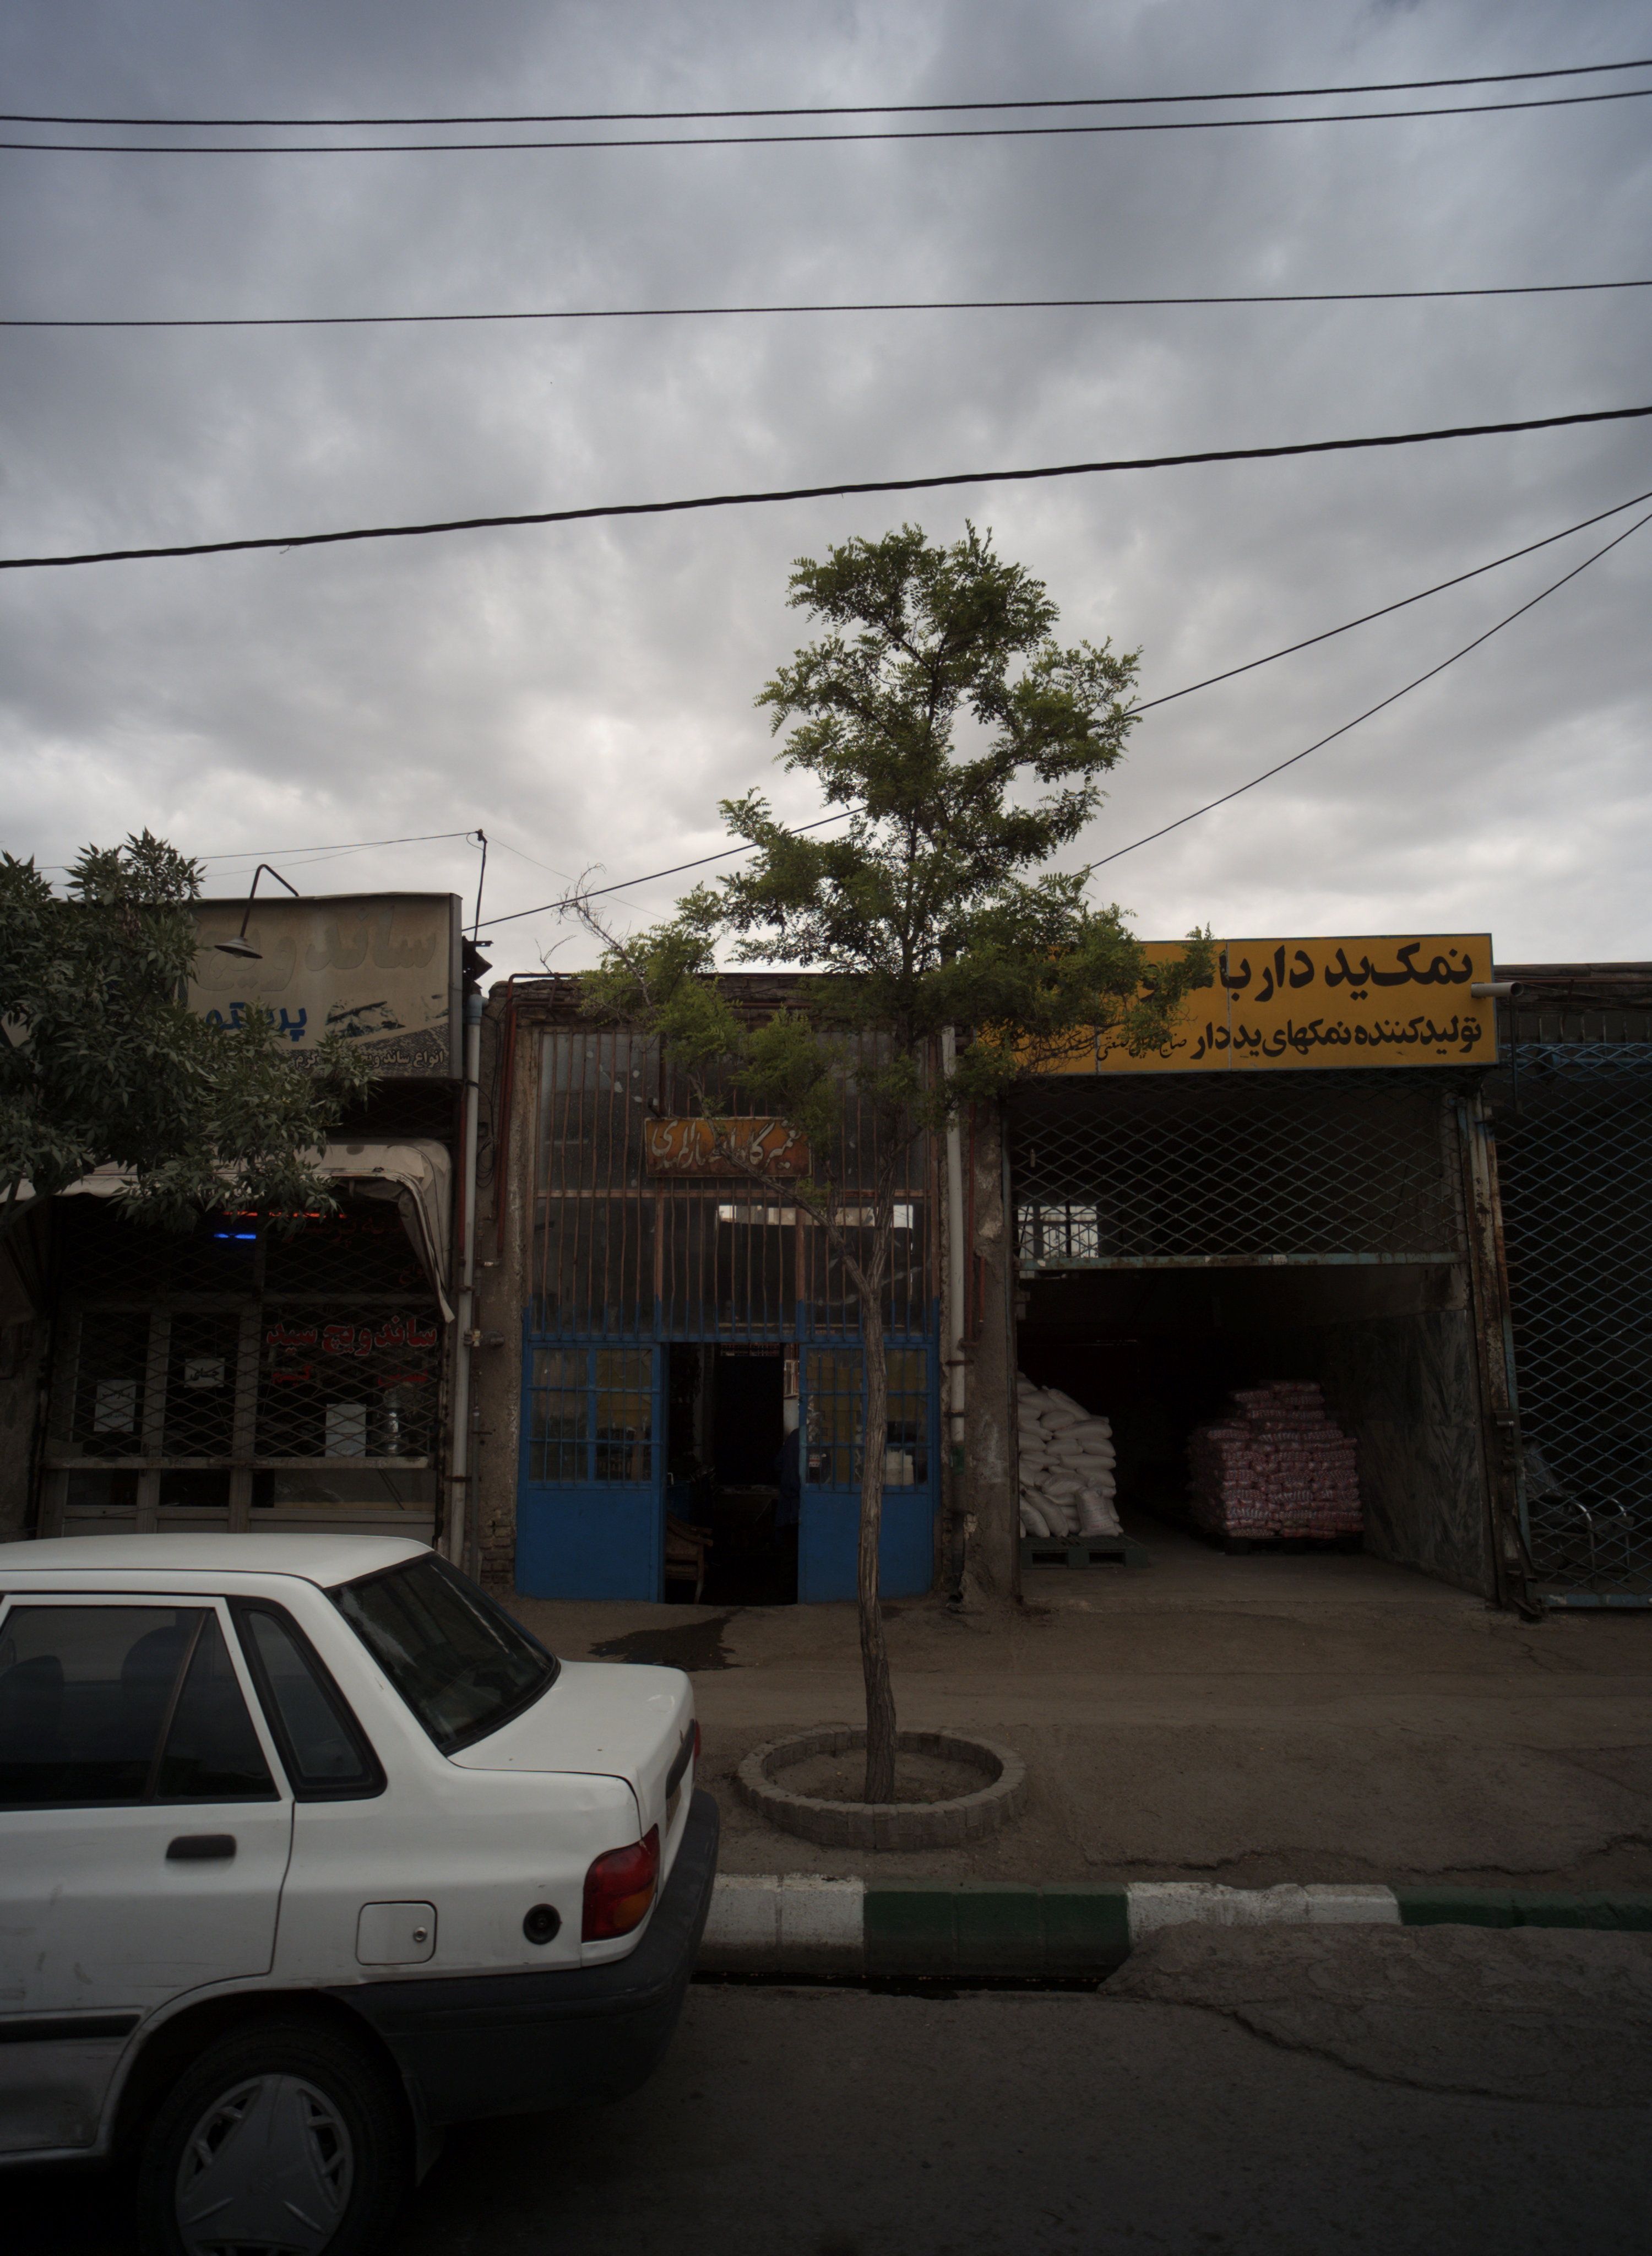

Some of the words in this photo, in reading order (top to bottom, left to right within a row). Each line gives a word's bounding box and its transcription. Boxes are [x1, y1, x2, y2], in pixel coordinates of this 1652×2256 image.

[1254, 945, 1314, 1002] دار
[205, 1002, 307, 1042] پرتو
[413, 1049, 445, 1069] انواع
